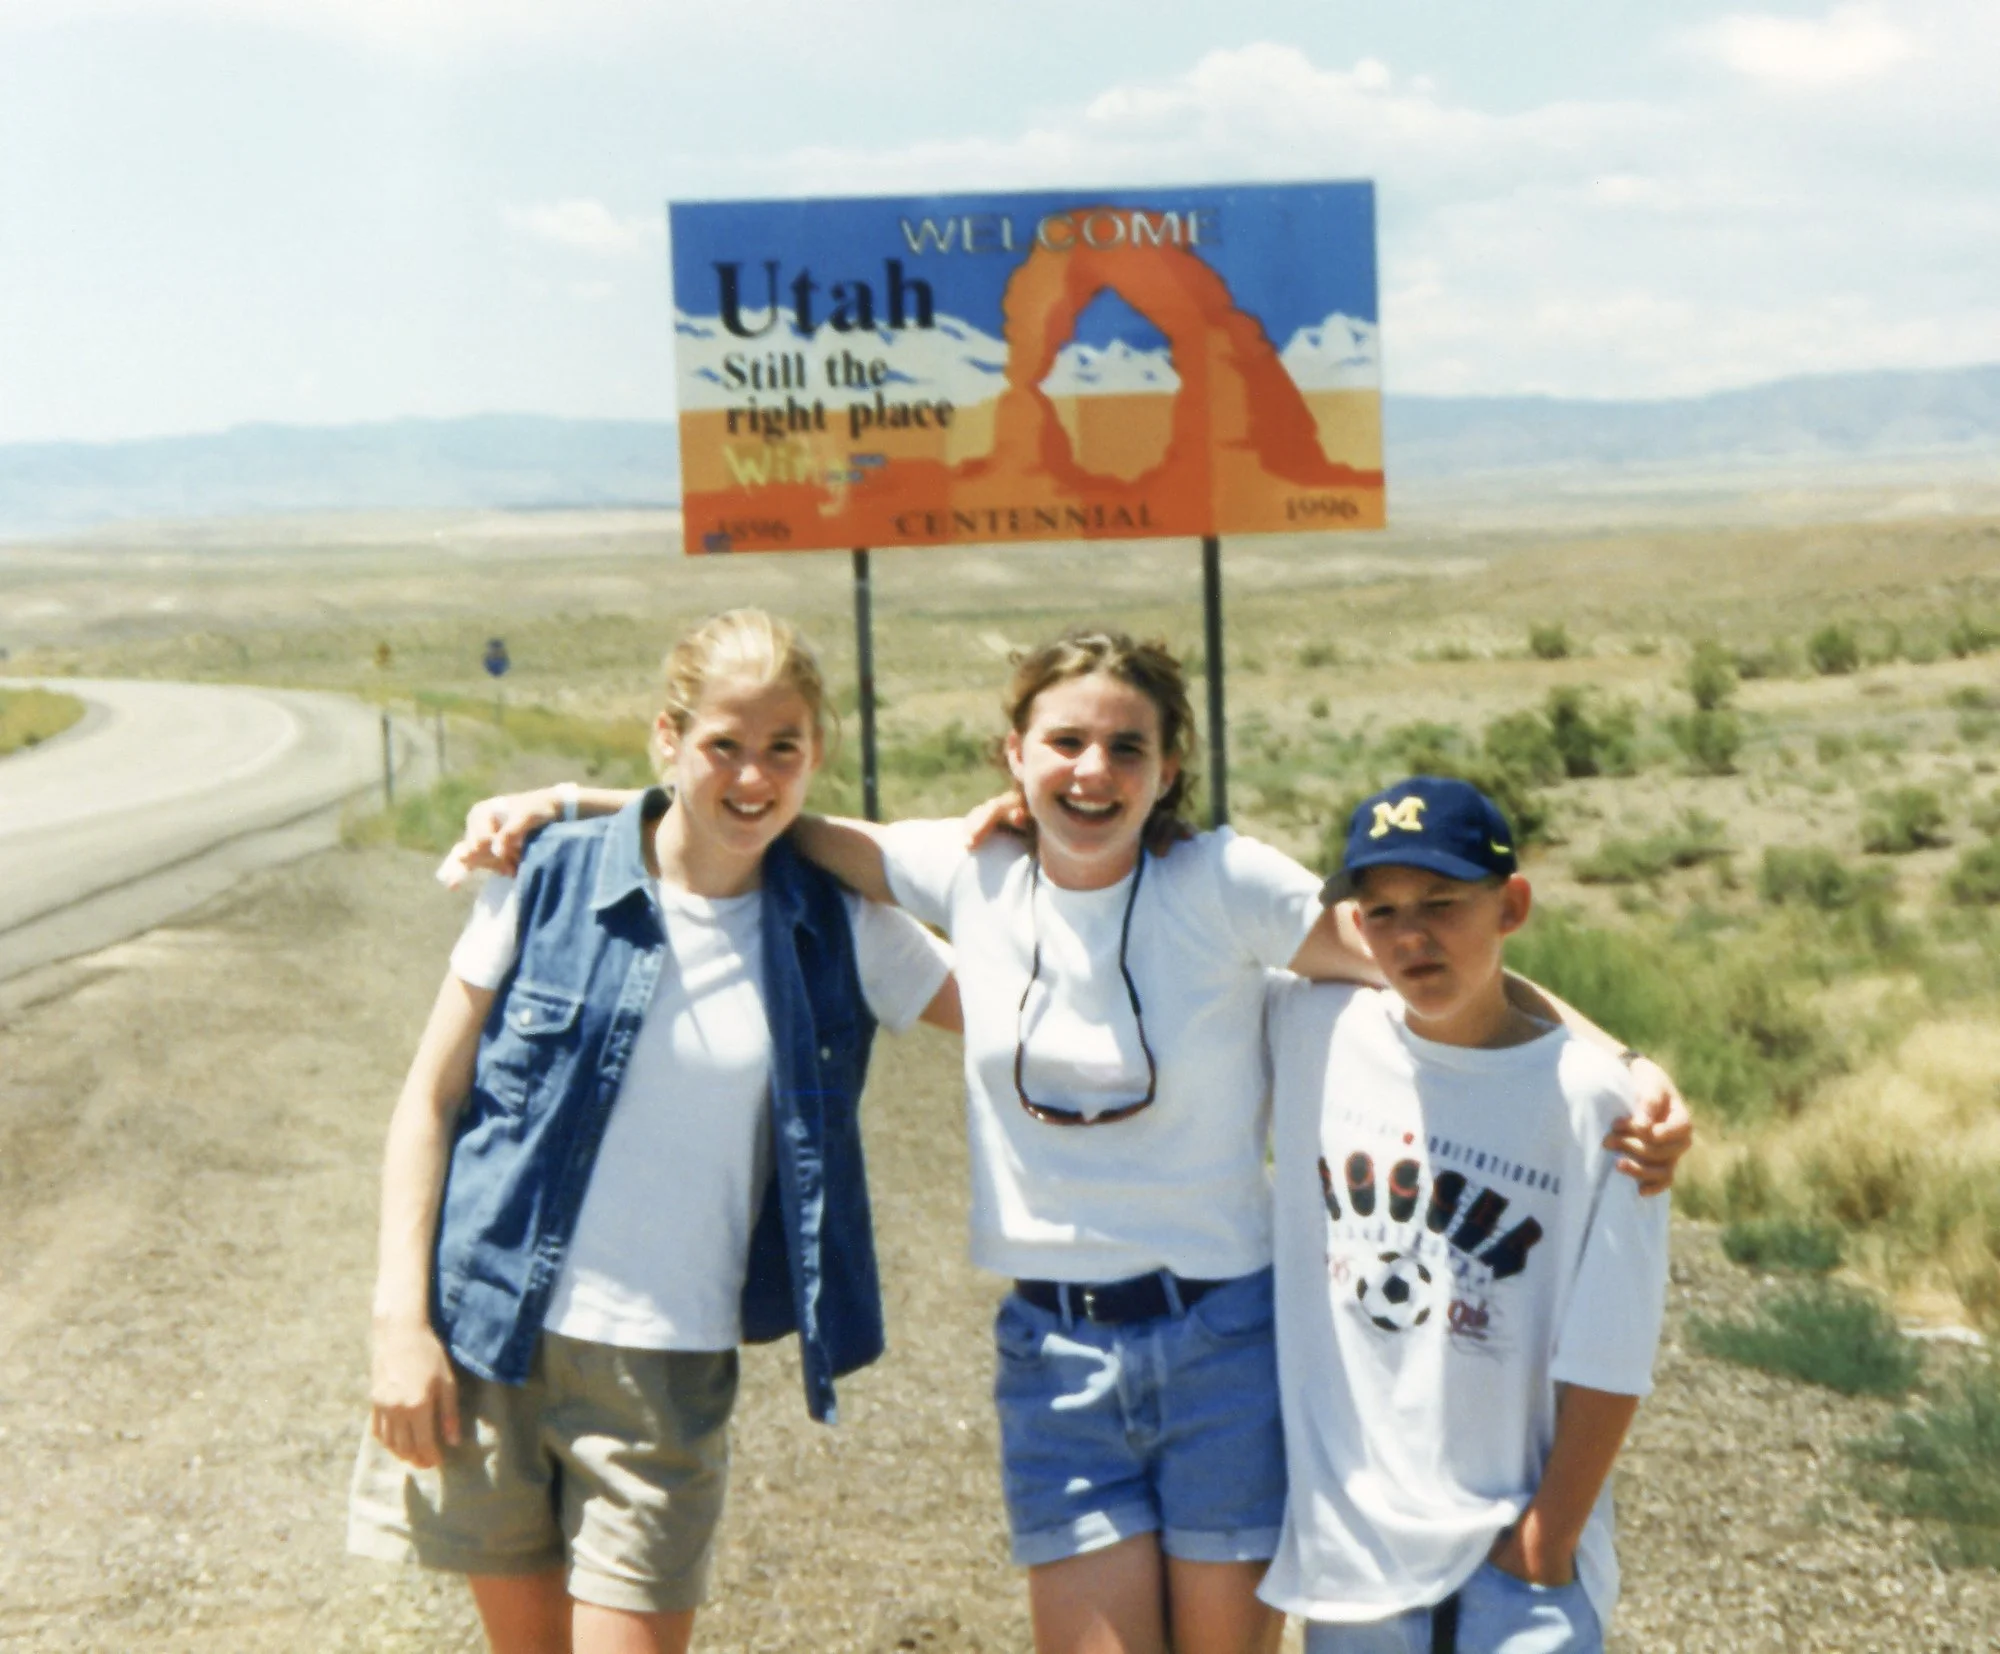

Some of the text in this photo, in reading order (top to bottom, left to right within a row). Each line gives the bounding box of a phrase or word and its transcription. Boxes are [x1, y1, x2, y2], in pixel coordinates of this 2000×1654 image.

[899, 206, 1222, 256] WELCOME
[711, 257, 936, 340] Utah
[722, 349, 889, 391] Still the
[726, 391, 955, 442] right place
[893, 504, 1162, 537] CENTENNIAL
[1368, 795, 1426, 839] M
